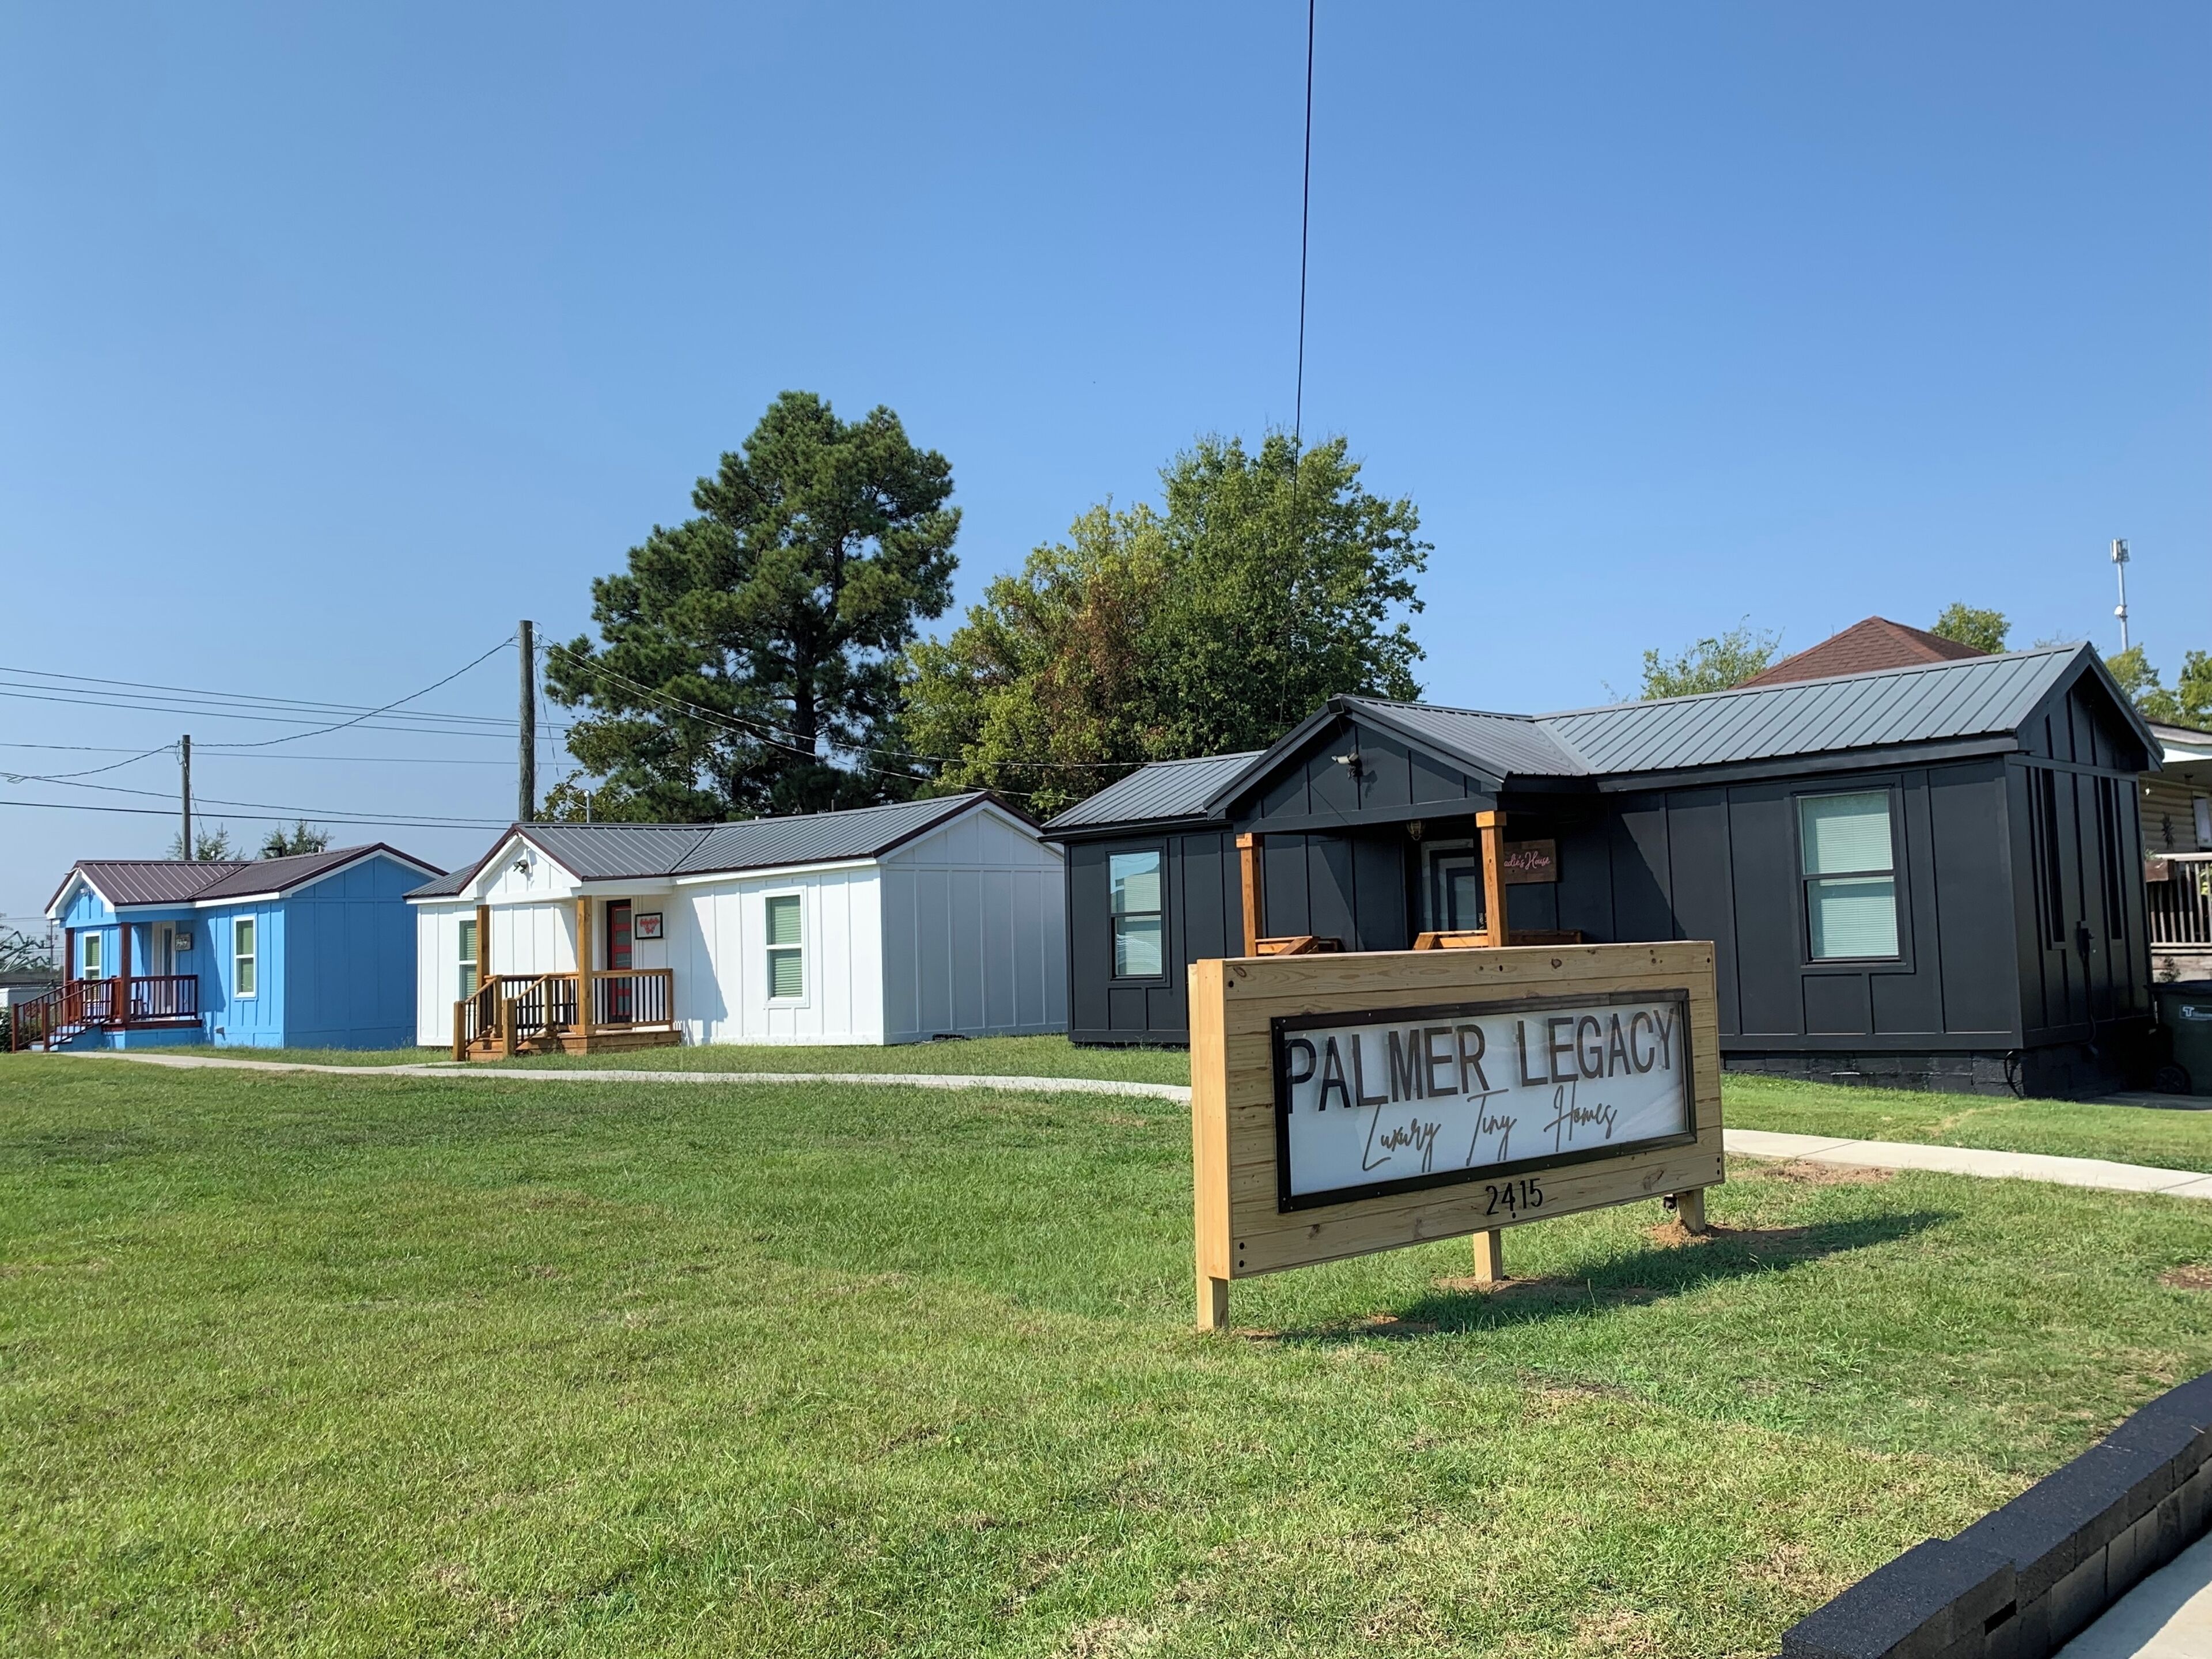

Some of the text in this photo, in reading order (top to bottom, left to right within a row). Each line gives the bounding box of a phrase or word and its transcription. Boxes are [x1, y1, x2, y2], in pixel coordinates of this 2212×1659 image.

[1503, 851, 1551, 870] adie's House
[1285, 1007, 1674, 1114] PALMER LEGACY
[1363, 1081, 1618, 1173] Luxury Tiny Homes
[1485, 1178, 1543, 1215] 2415
